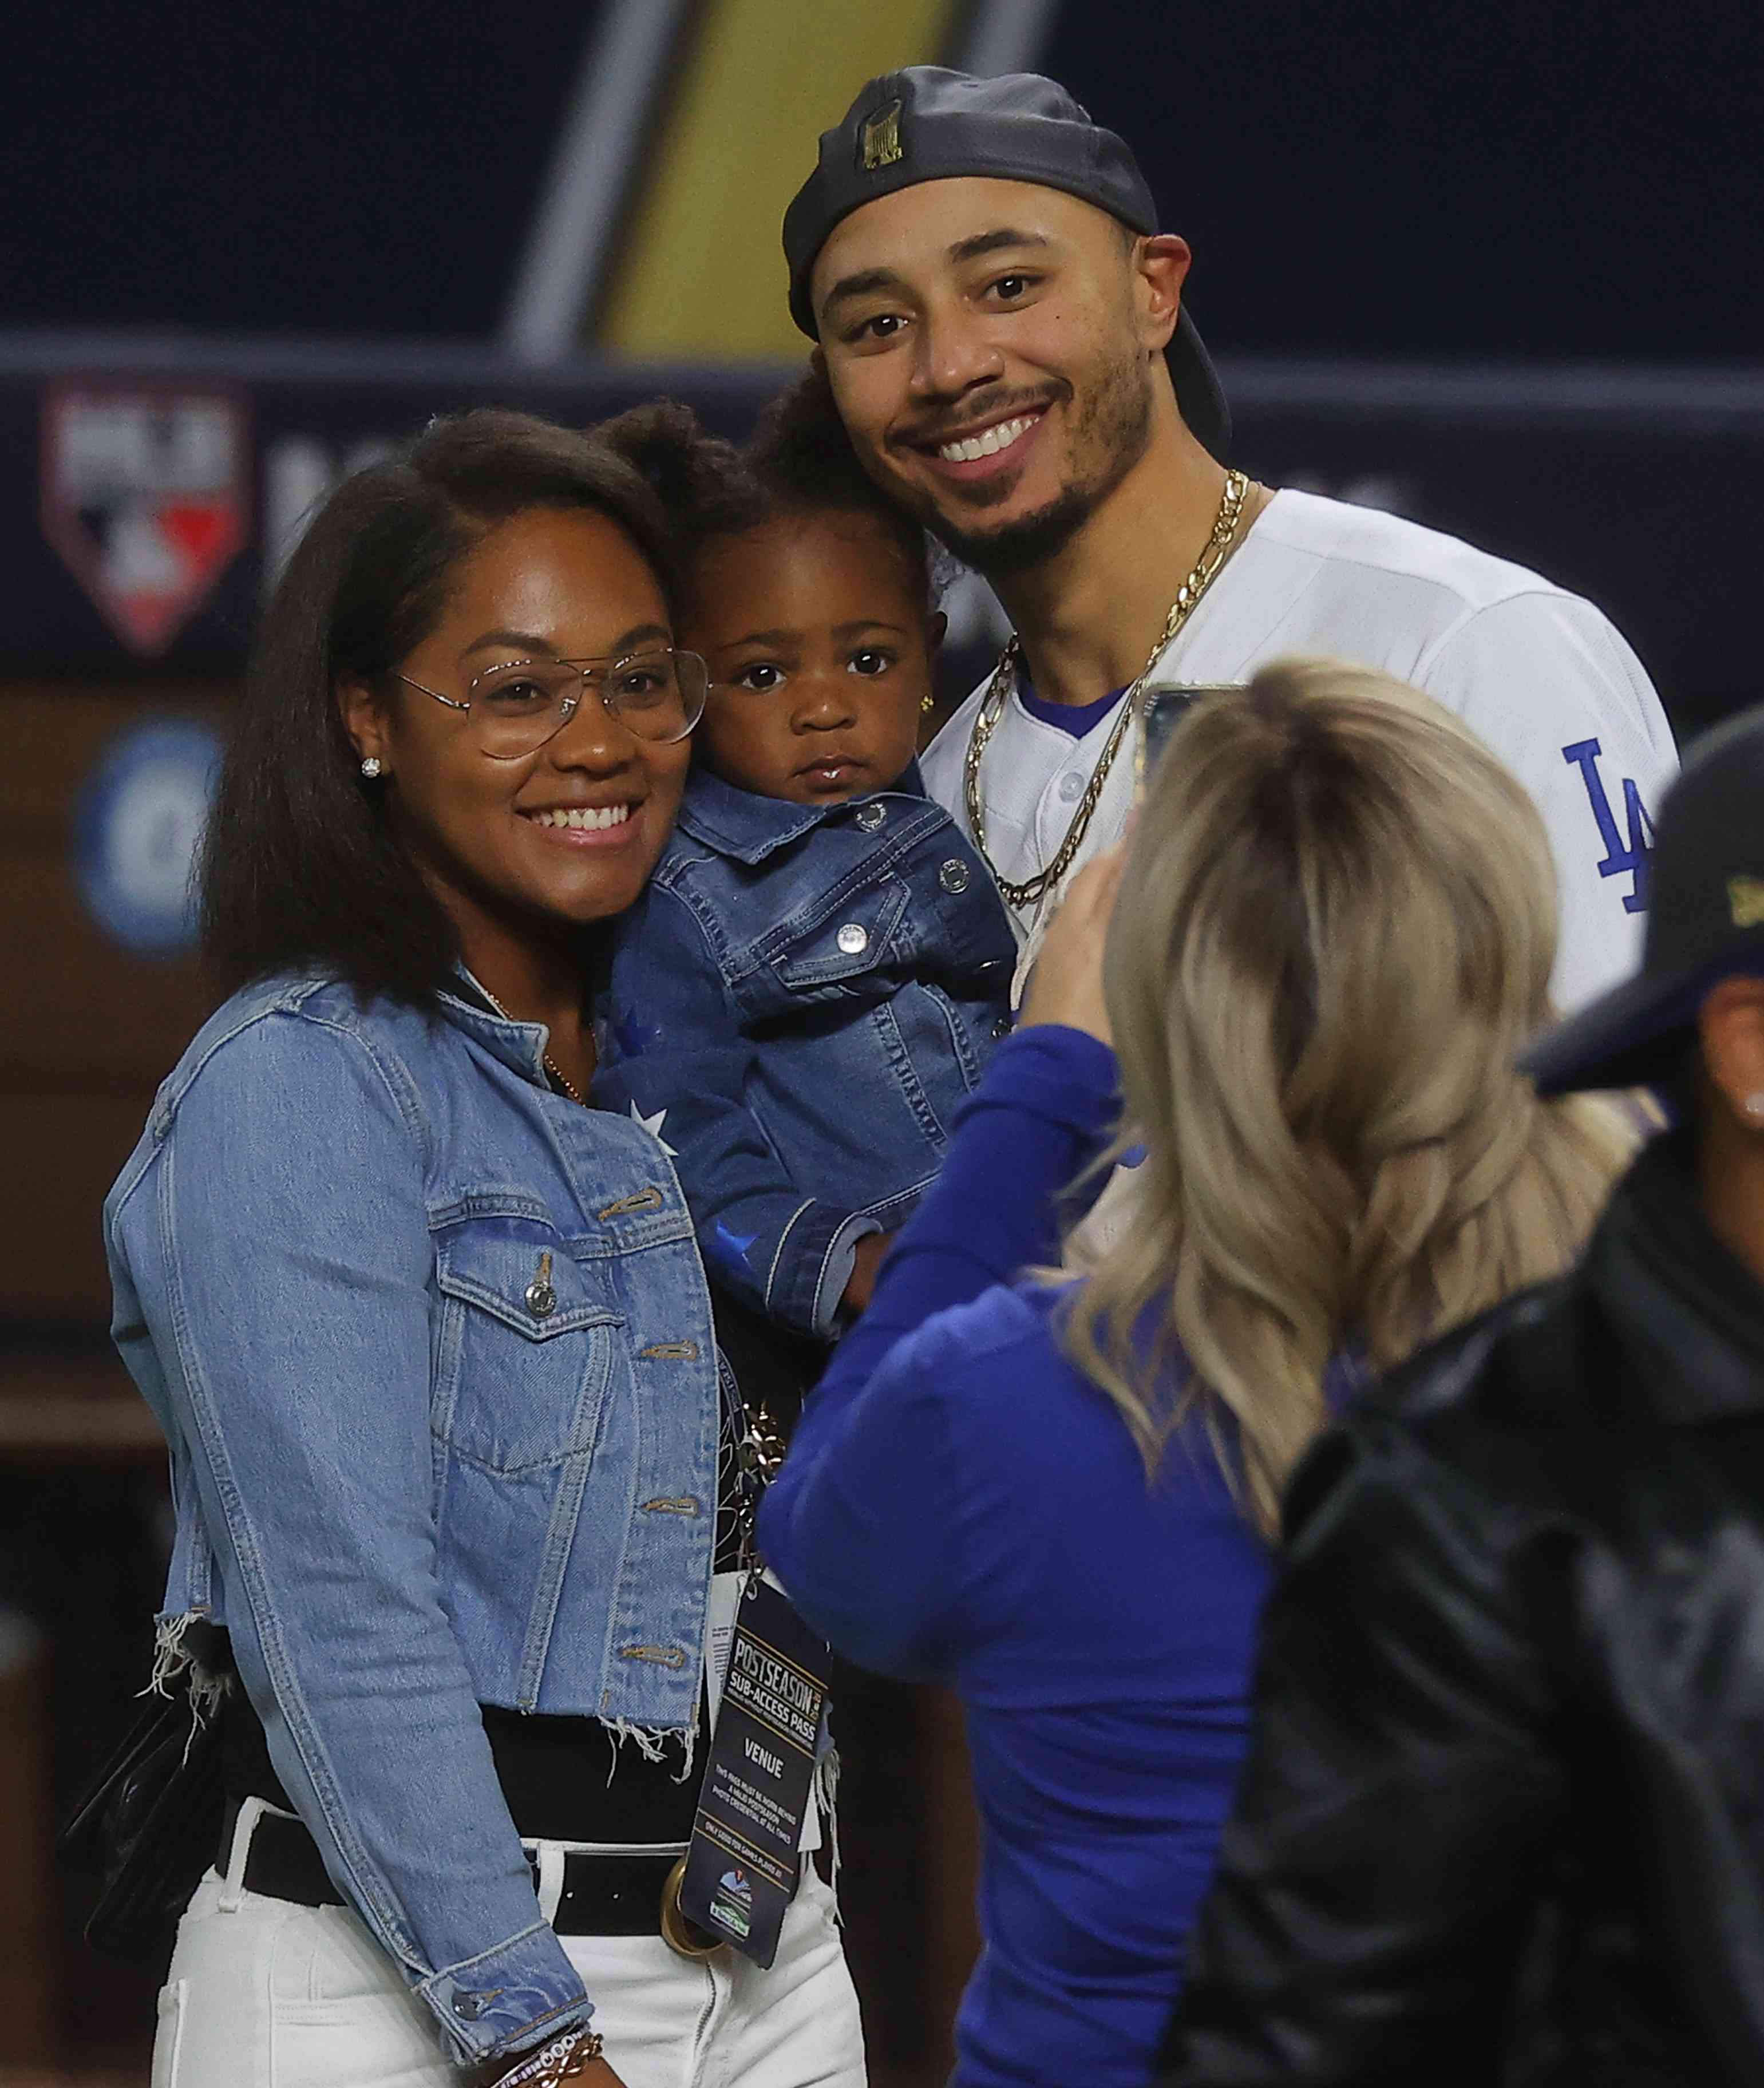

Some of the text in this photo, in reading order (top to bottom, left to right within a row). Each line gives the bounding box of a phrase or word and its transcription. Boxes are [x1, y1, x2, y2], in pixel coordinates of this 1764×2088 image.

[730, 1671, 790, 1723] SUB-ACCESS
[790, 1713, 816, 1741] PASS
[734, 1638, 813, 1714] POSTSEASON
[745, 1738, 784, 1779] VENUE
